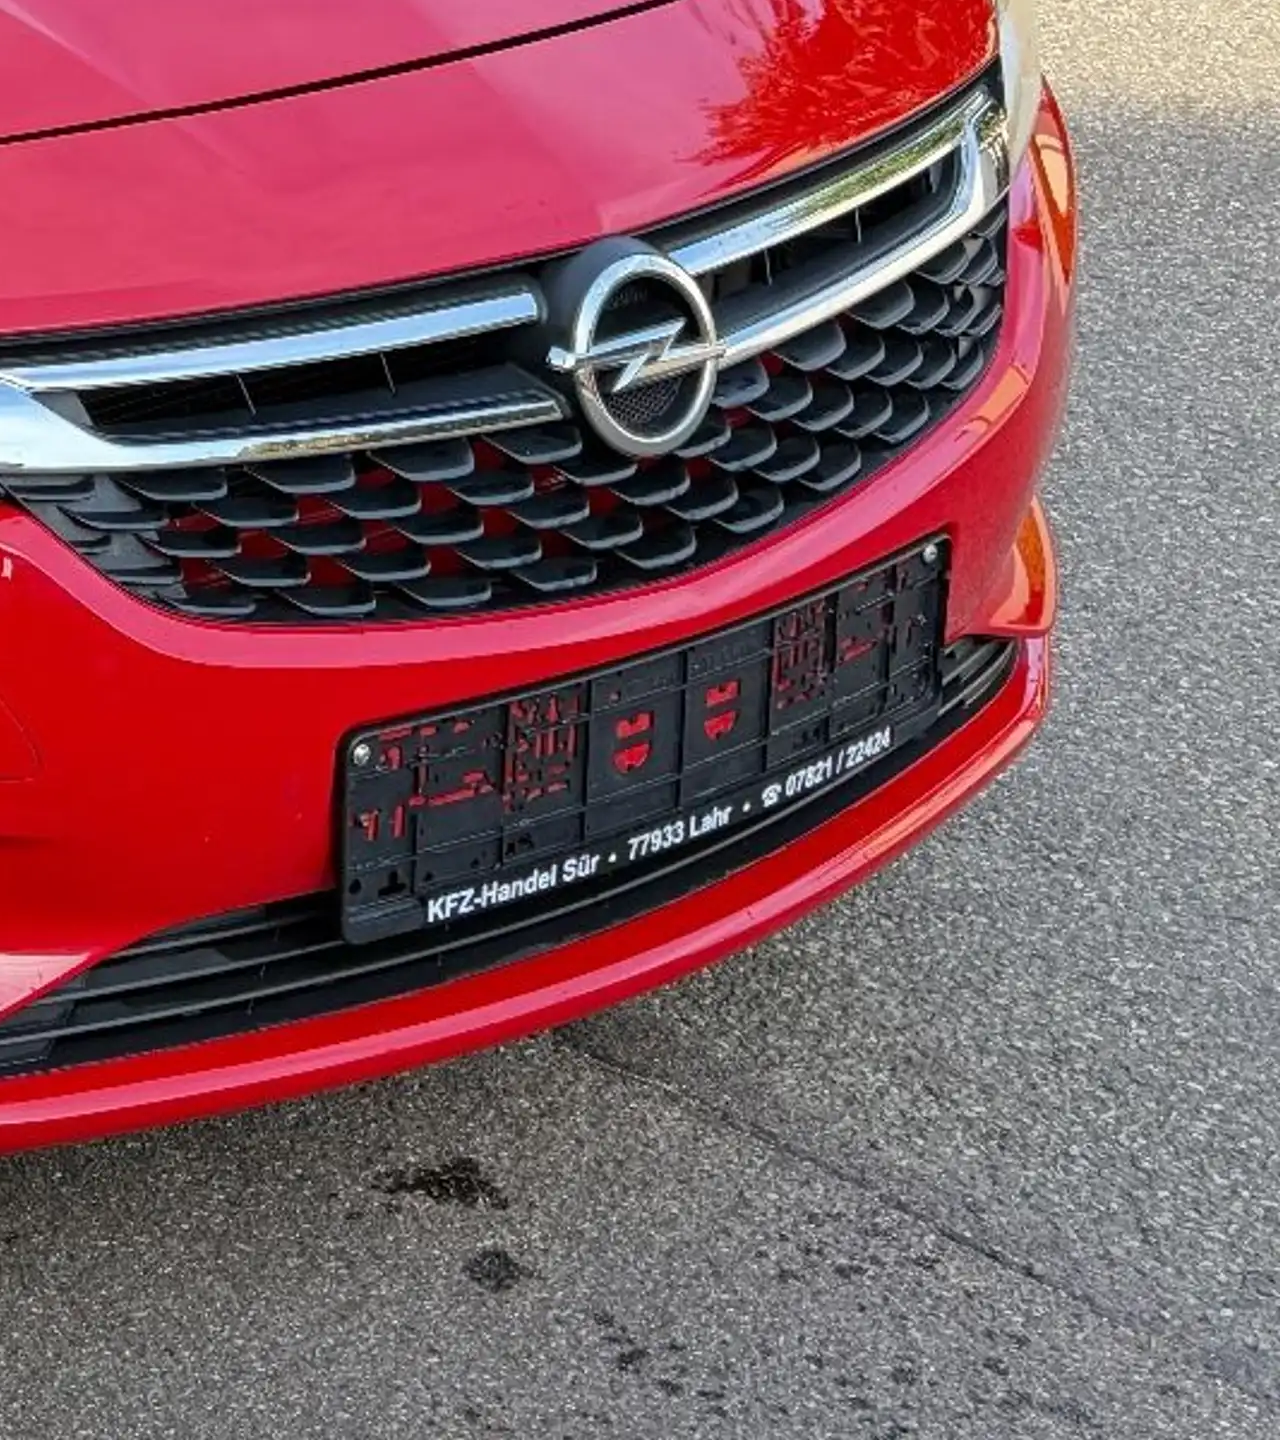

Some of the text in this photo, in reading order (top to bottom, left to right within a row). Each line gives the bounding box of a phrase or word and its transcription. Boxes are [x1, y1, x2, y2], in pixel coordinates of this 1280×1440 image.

[427, 864, 558, 923] KFZ-Handel
[562, 854, 600, 882] Sür
[627, 820, 685, 860] 77933
[689, 806, 733, 838] Lahr
[785, 755, 833, 796] 07821
[845, 725, 890, 769] 22424
